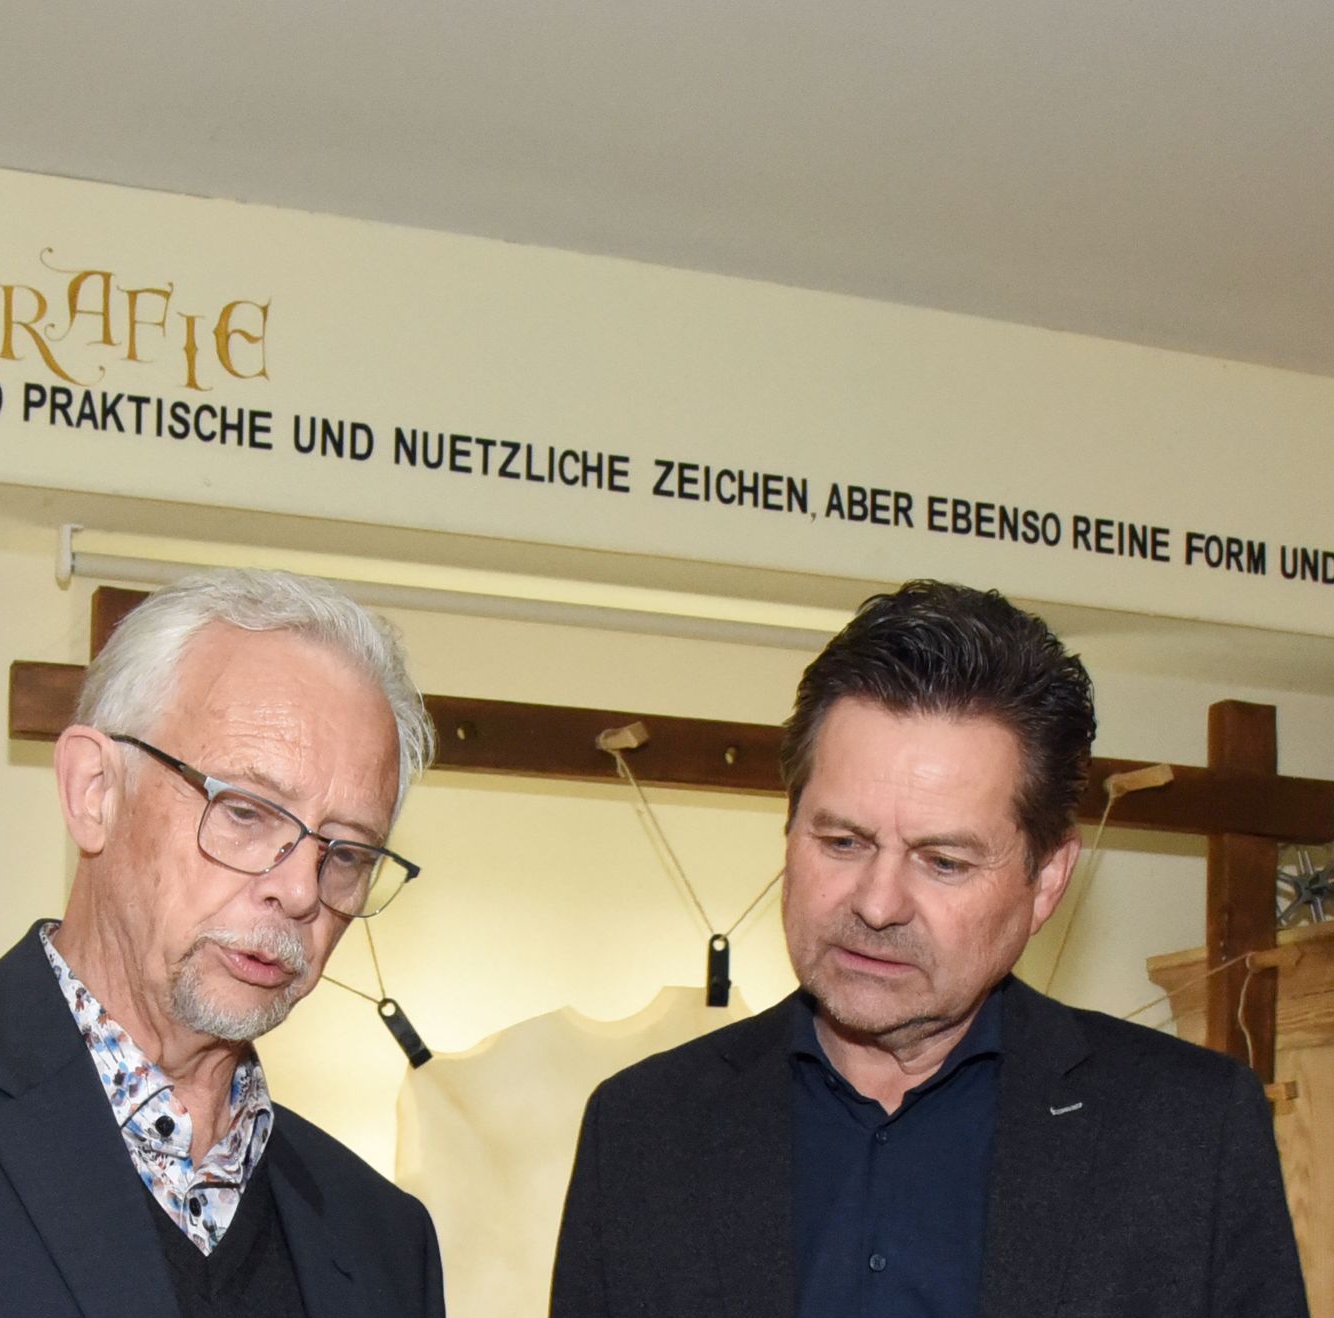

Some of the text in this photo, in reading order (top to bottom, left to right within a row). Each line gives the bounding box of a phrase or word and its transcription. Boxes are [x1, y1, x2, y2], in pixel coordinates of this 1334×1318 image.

[22, 382, 274, 451] PRAKTISCHE
[292, 414, 375, 462] UND
[393, 427, 631, 494] NUETZLICHE
[651, 458, 819, 524] ZEICHEN,
[824, 482, 915, 529] ABER
[926, 495, 1061, 548] EBENSO
[1071, 515, 1172, 563] REINE
[1184, 530, 1267, 577] FORM
